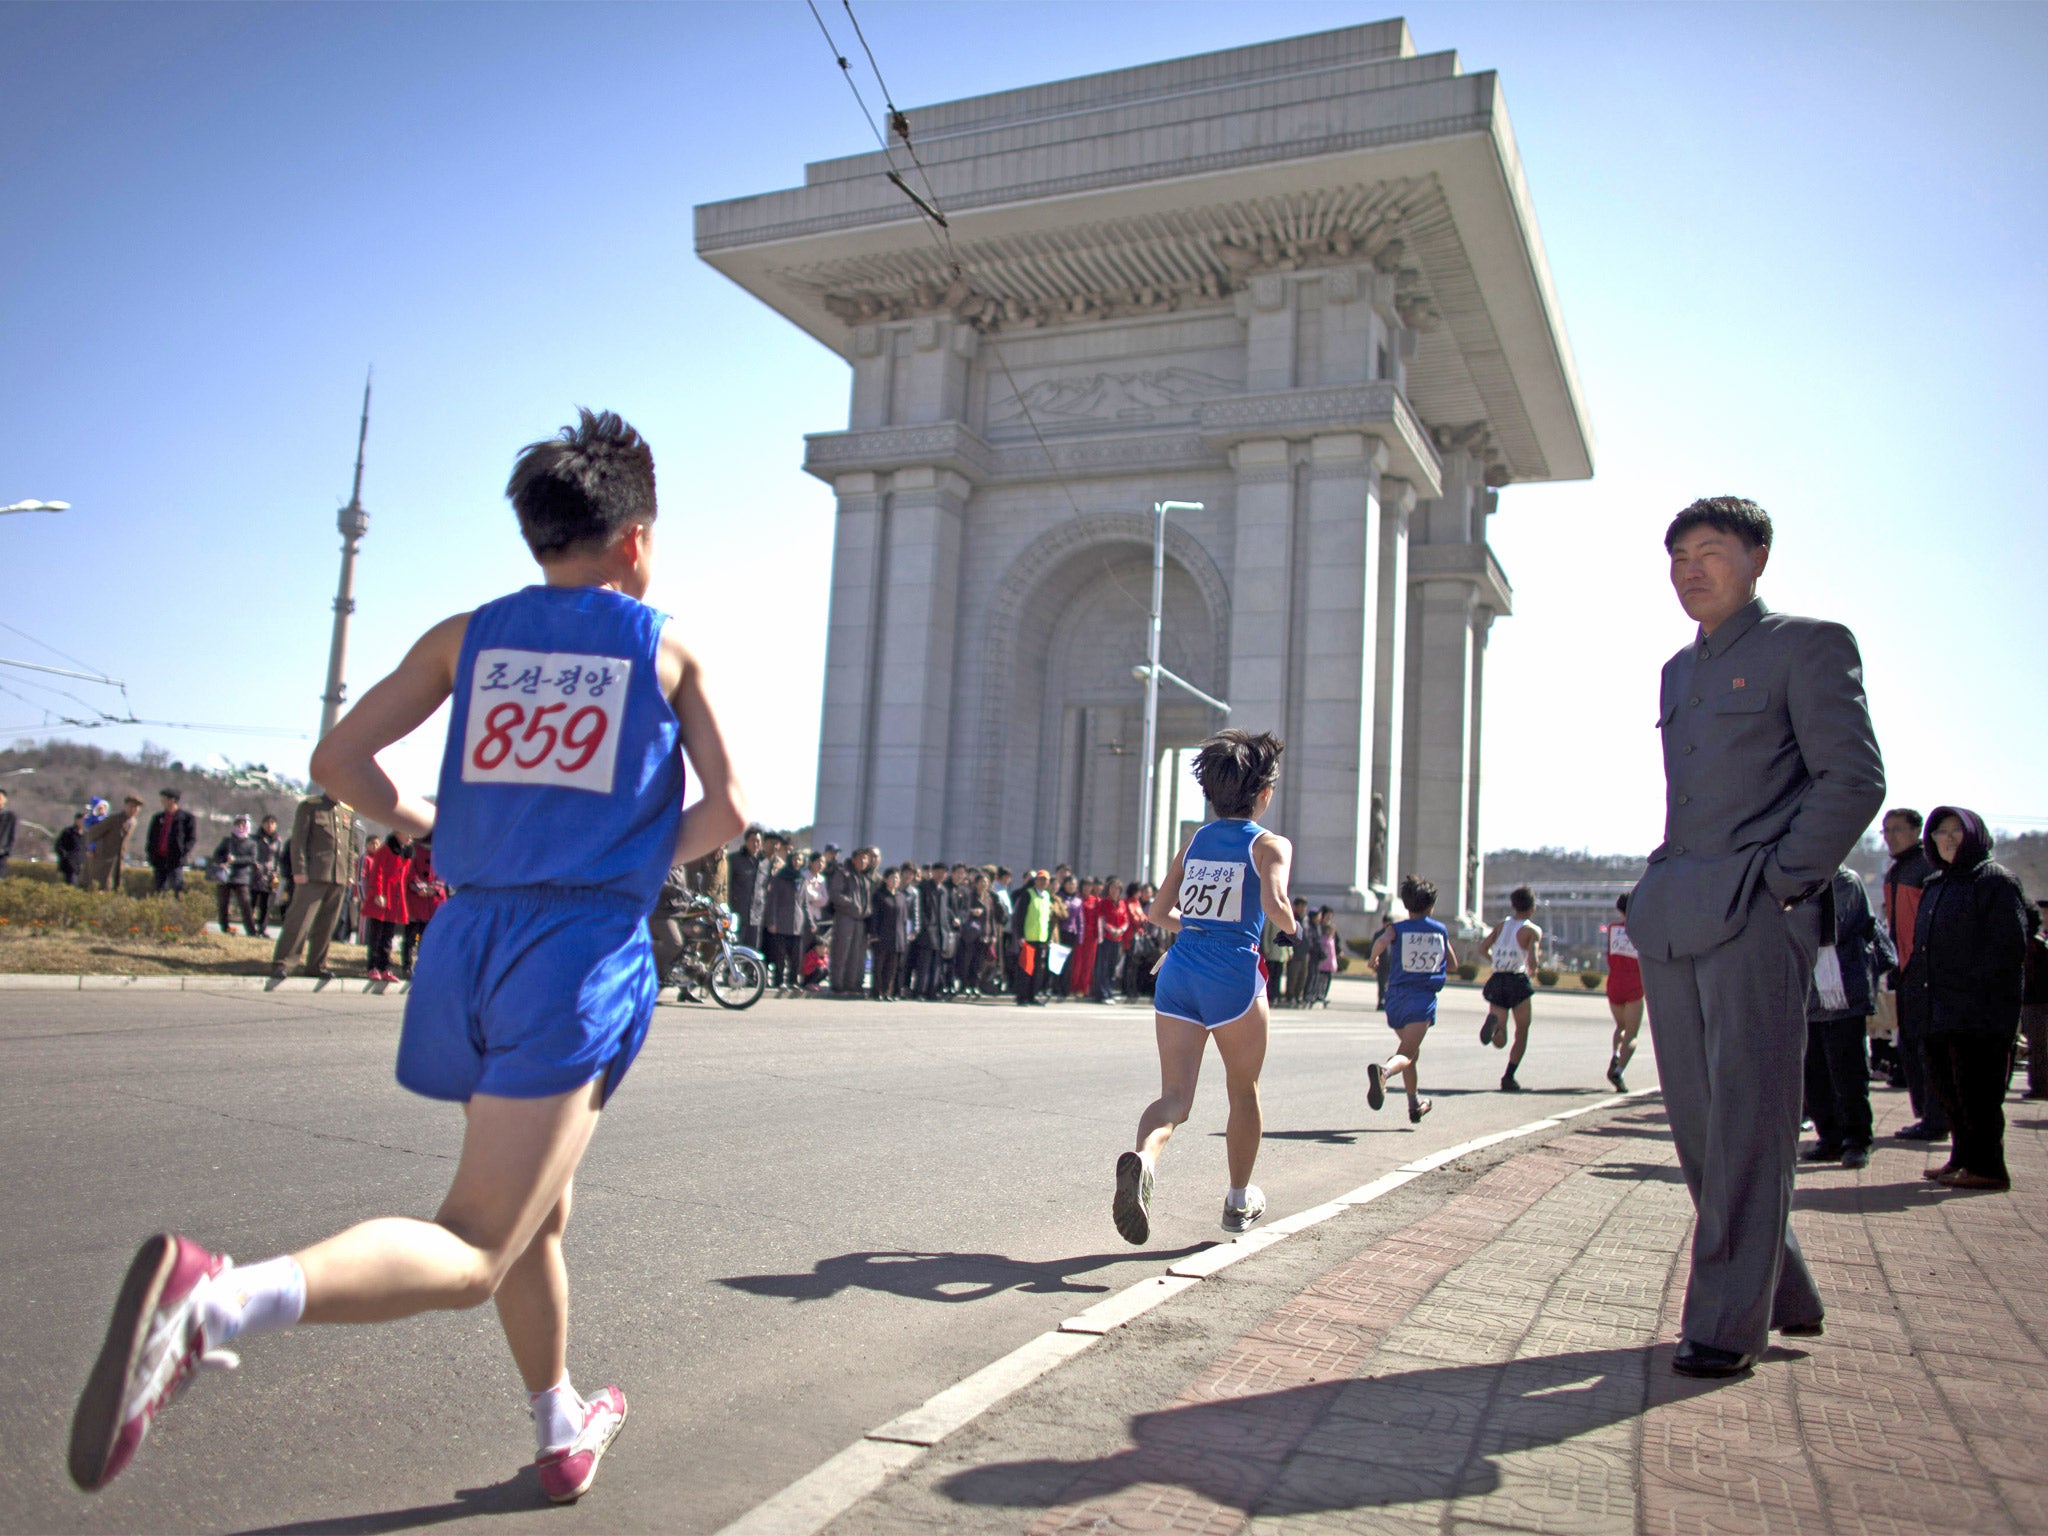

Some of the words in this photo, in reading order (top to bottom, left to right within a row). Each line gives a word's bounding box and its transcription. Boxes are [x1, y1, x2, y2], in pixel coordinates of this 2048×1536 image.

[480, 663, 612, 696] 조선-평양
[472, 702, 608, 773] 859
[1183, 884, 1232, 917] 251
[1405, 951, 1438, 969] 355
